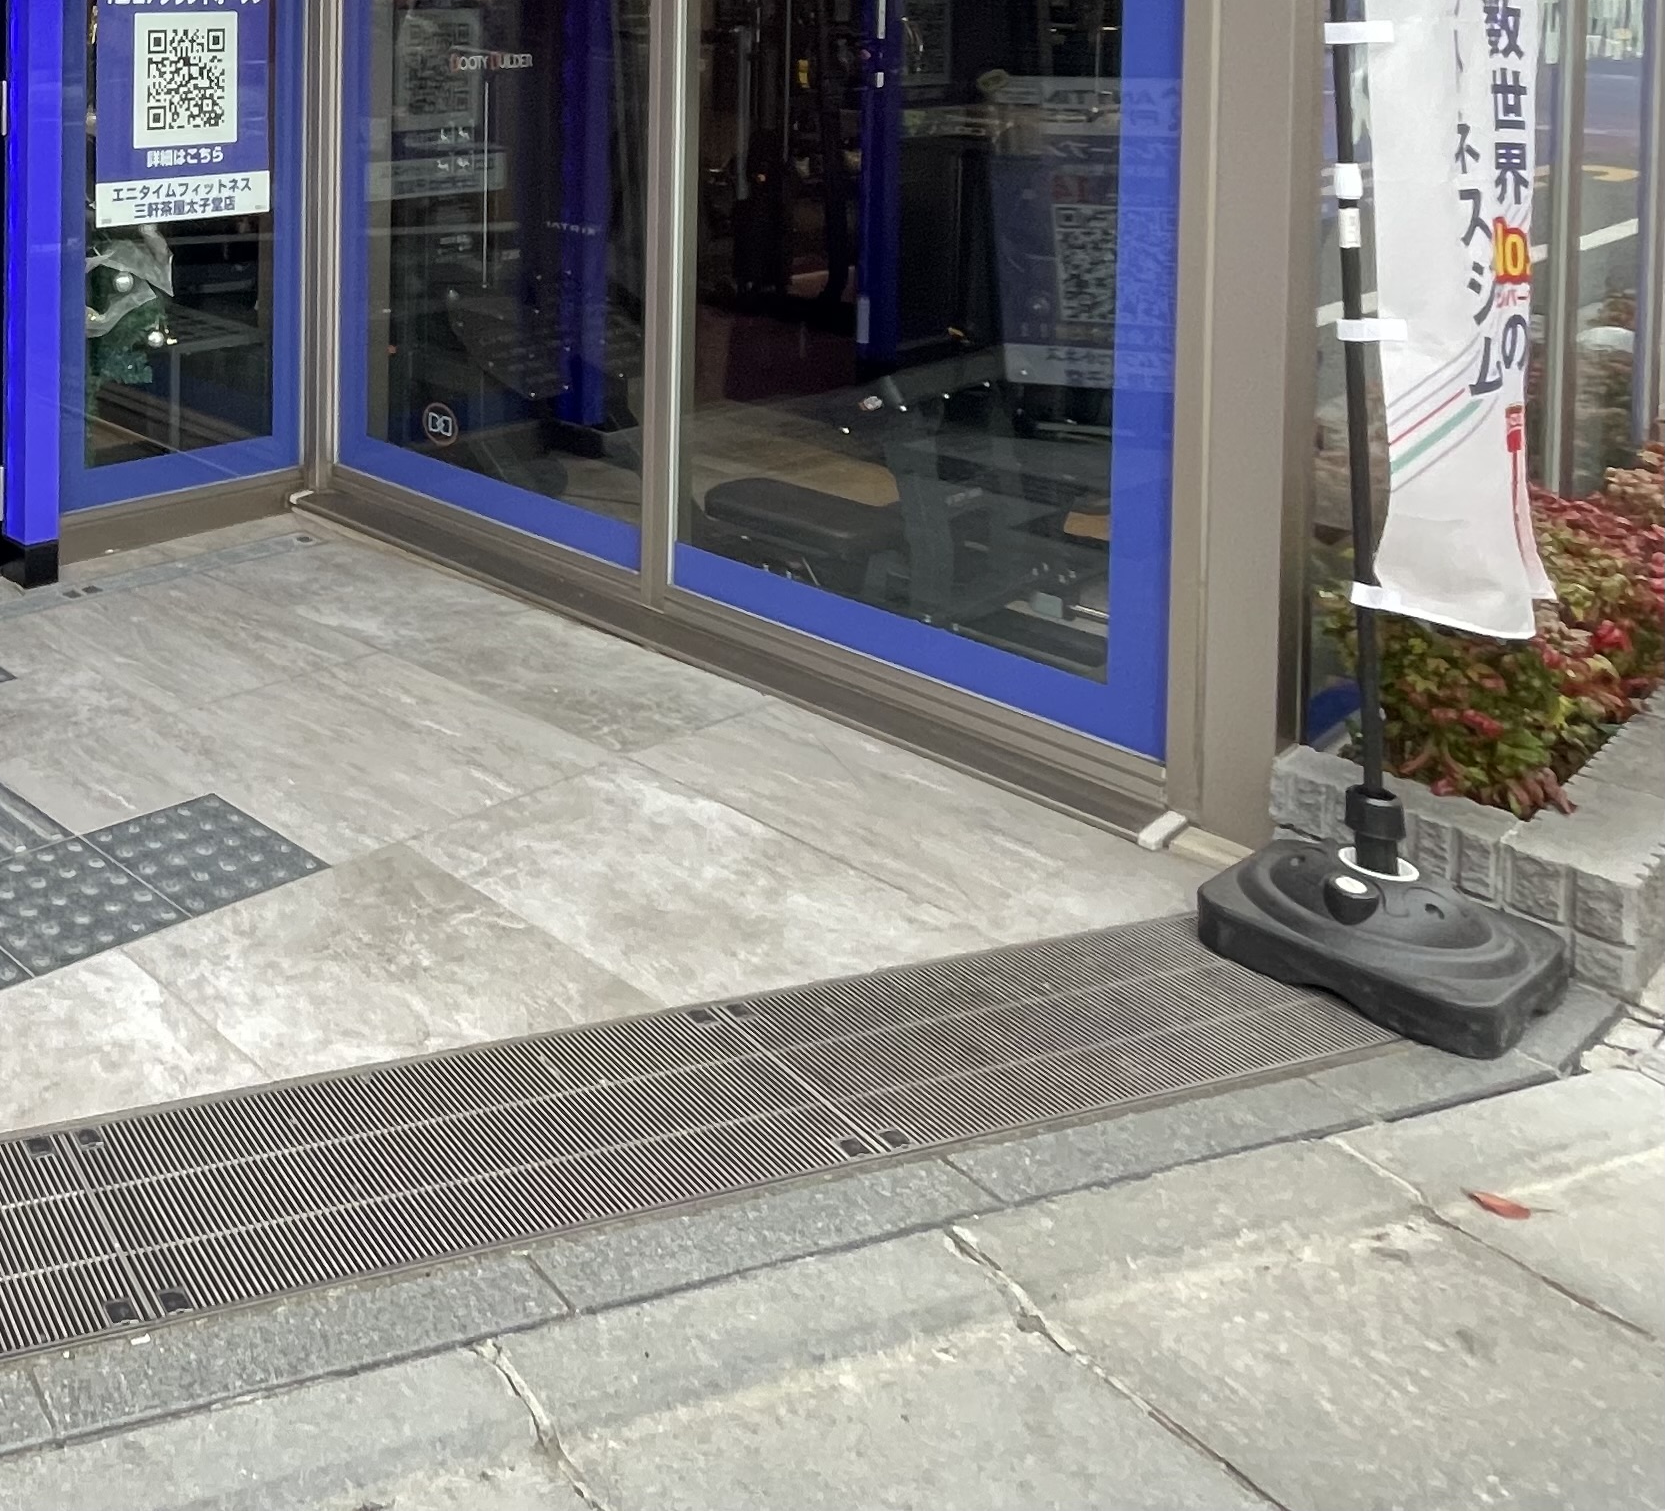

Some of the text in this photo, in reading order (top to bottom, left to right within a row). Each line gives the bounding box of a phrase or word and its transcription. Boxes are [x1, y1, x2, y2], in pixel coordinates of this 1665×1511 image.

[146, 146, 224, 168] 詳細はこちら
[112, 177, 252, 203] エニタイムフィットネス
[134, 195, 236, 219] 三軒茶屋太子堂店
